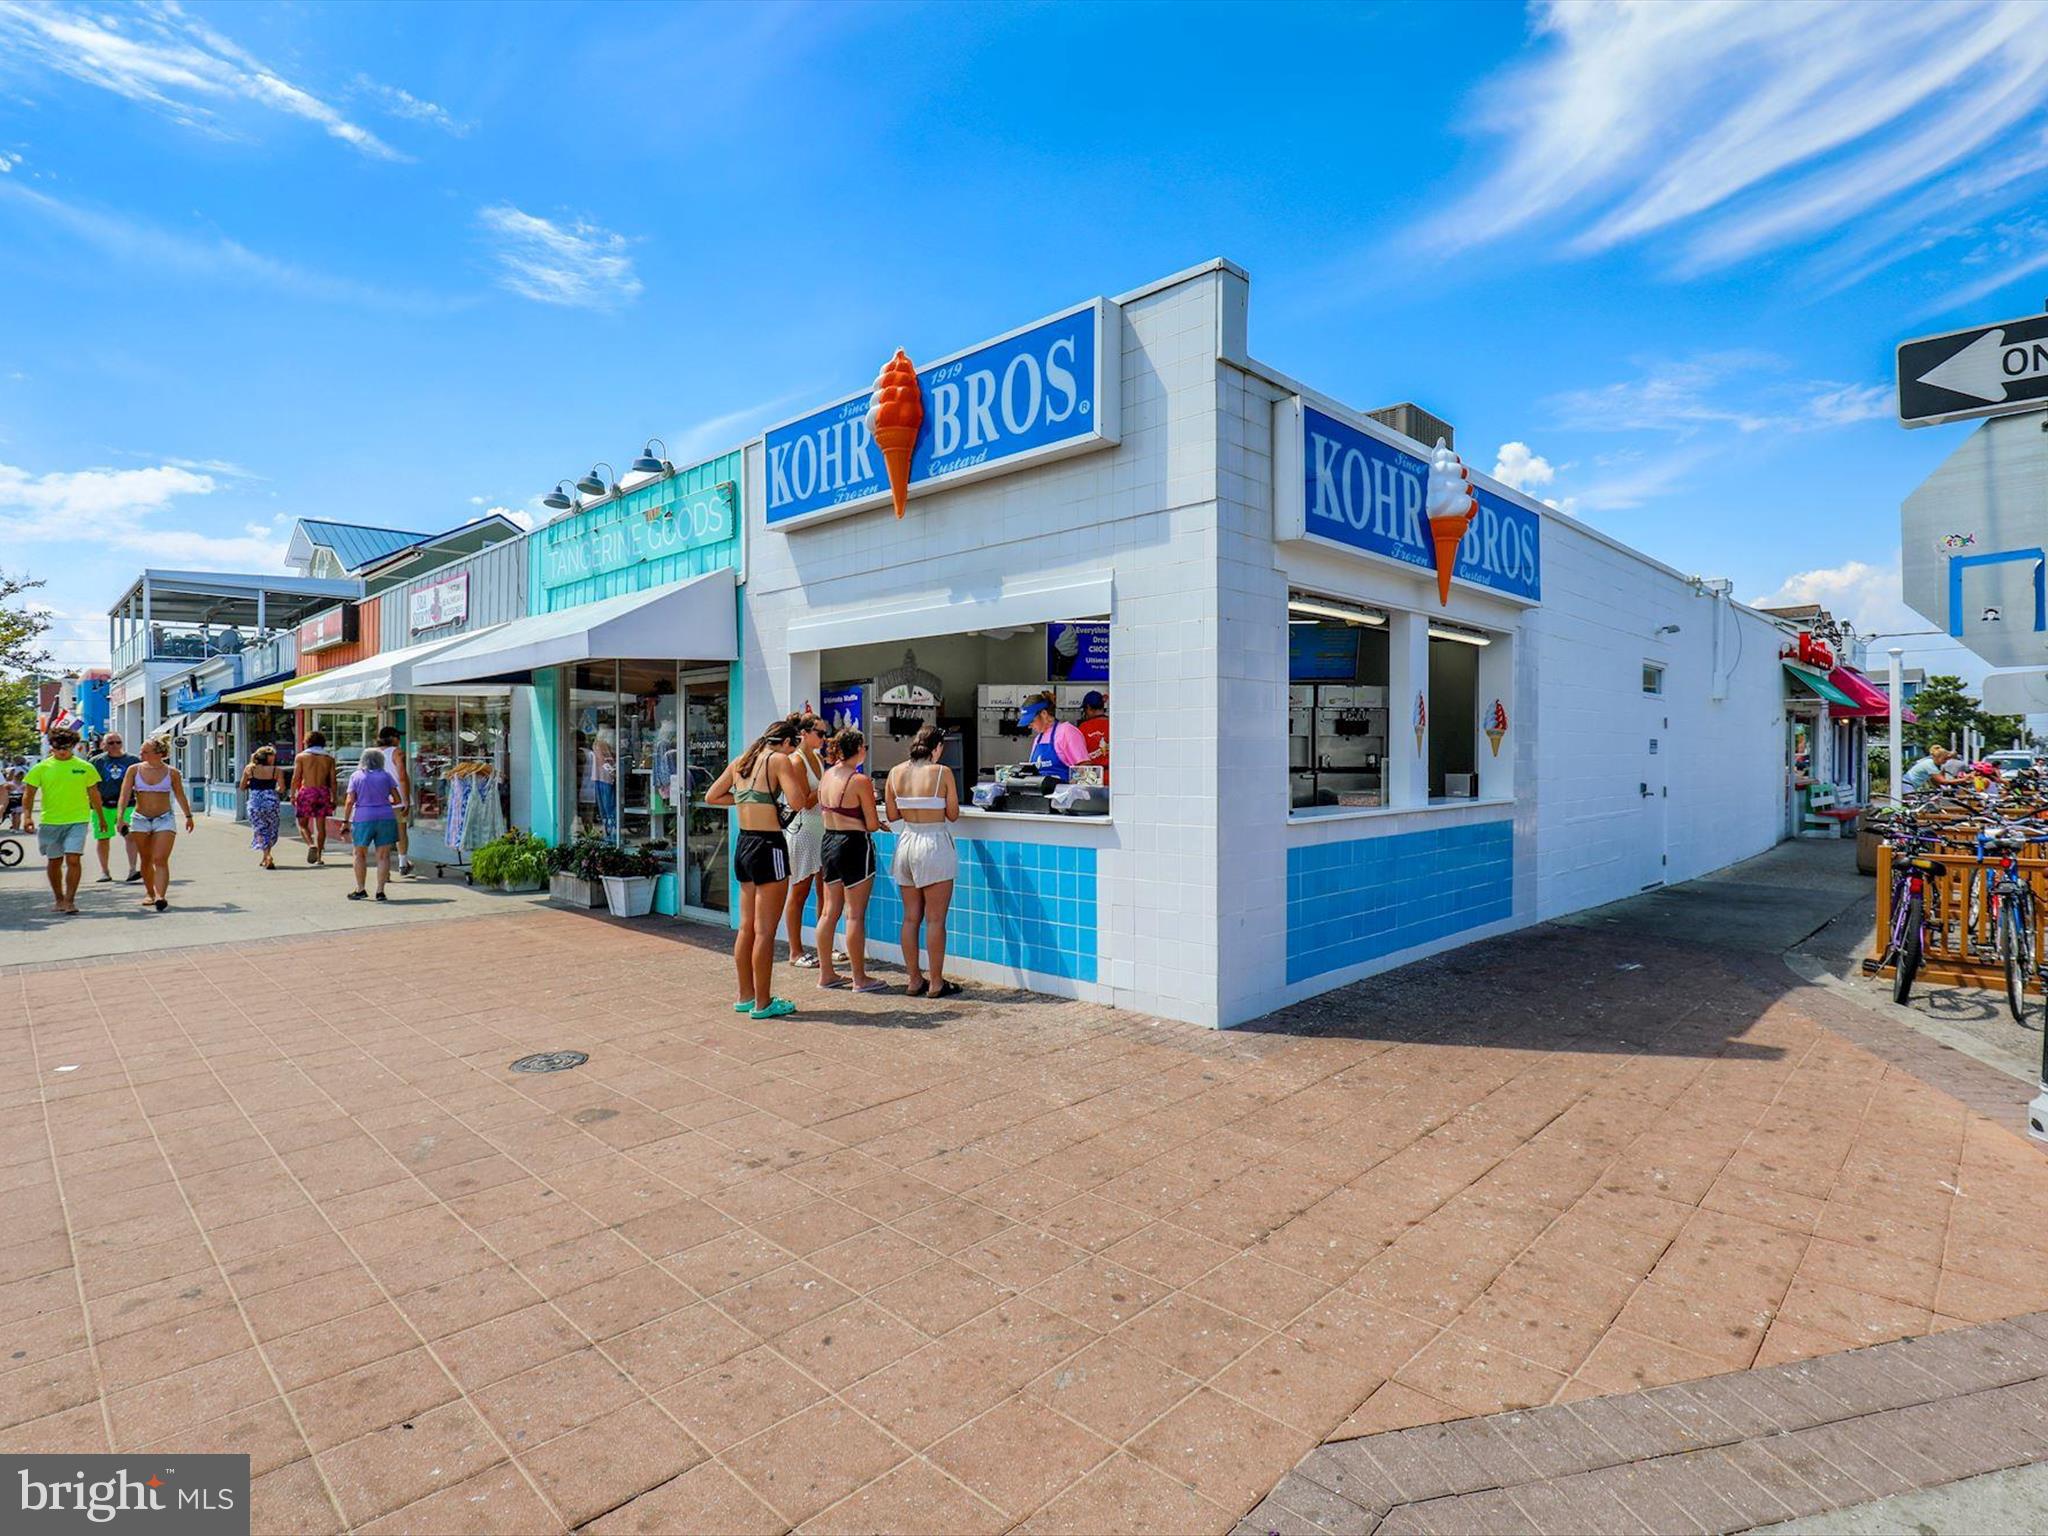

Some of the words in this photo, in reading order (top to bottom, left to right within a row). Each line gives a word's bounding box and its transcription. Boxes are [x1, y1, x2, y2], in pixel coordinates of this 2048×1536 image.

[931, 362, 963, 384] 1919
[769, 415, 875, 508] KOHR
[930, 335, 1077, 459] BROS
[834, 484, 879, 505] Frozen
[927, 449, 988, 478] Custard
[1395, 452, 1427, 474] Since
[648, 496, 723, 550] GOODS
[1311, 431, 1426, 549] KOHR
[1462, 505, 1534, 586] BROS
[1391, 543, 1429, 567] Frozen
[1460, 564, 1492, 585] Custard
